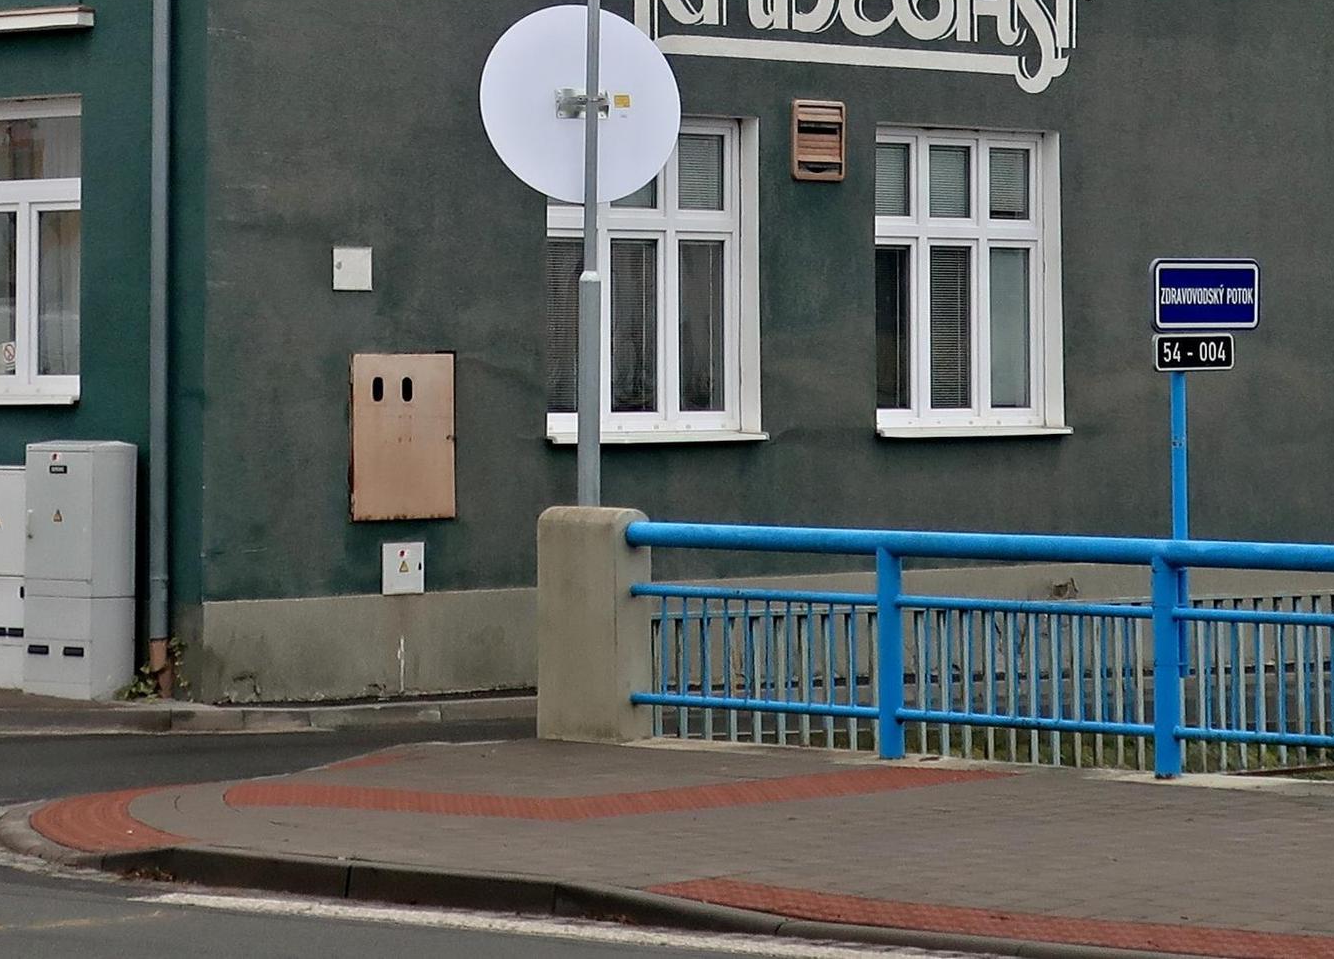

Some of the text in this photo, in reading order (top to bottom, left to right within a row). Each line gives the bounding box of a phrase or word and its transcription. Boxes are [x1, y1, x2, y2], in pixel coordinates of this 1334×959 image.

[1160, 284, 1254, 305] ZDRAVOVODSKÝ POTOK
[1163, 341, 1181, 363] 54
[1199, 341, 1226, 362] 004
